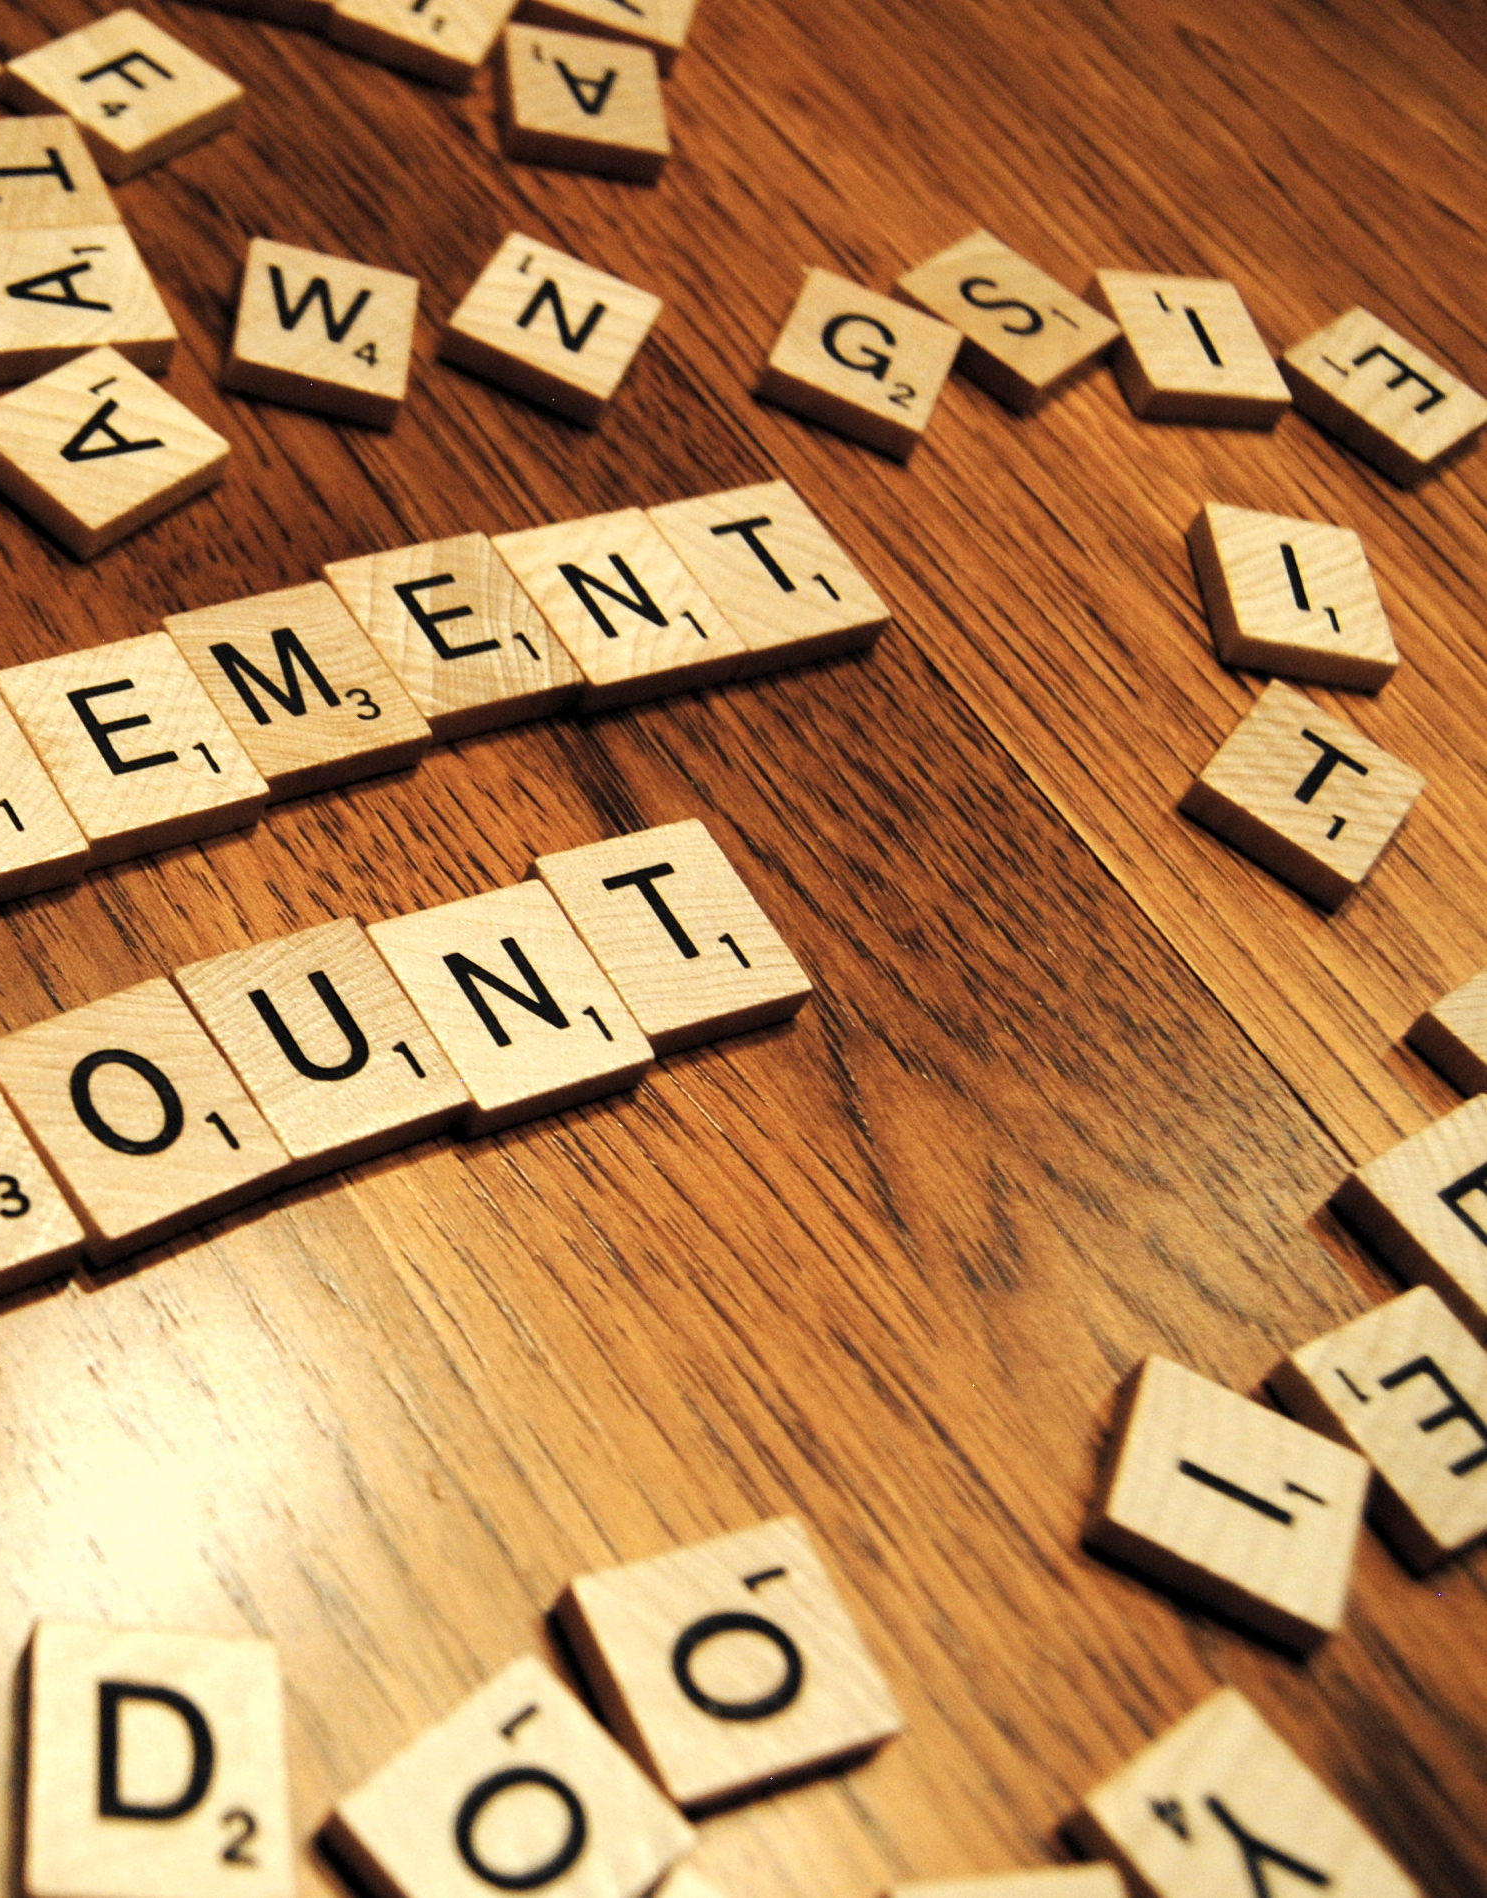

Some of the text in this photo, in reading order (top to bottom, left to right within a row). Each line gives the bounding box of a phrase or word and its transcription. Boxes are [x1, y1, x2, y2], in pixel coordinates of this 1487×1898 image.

[78, 50, 173, 90] F
[554, 59, 618, 116] A
[5, 261, 113, 313] A
[267, 264, 372, 344] W
[516, 278, 607, 353] N
[959, 276, 1044, 337] S
[820, 312, 897, 382] G
[1184, 307, 1223, 367] I
[1352, 344, 1447, 415] E
[59, 398, 165, 463] A
[1279, 543, 1311, 612] I
[1294, 728, 1369, 805] T
[1178, 1459, 1295, 1527] I
[671, 1611, 805, 1724] O
[96, 1679, 216, 1825] D
[453, 1766, 589, 1895] O
